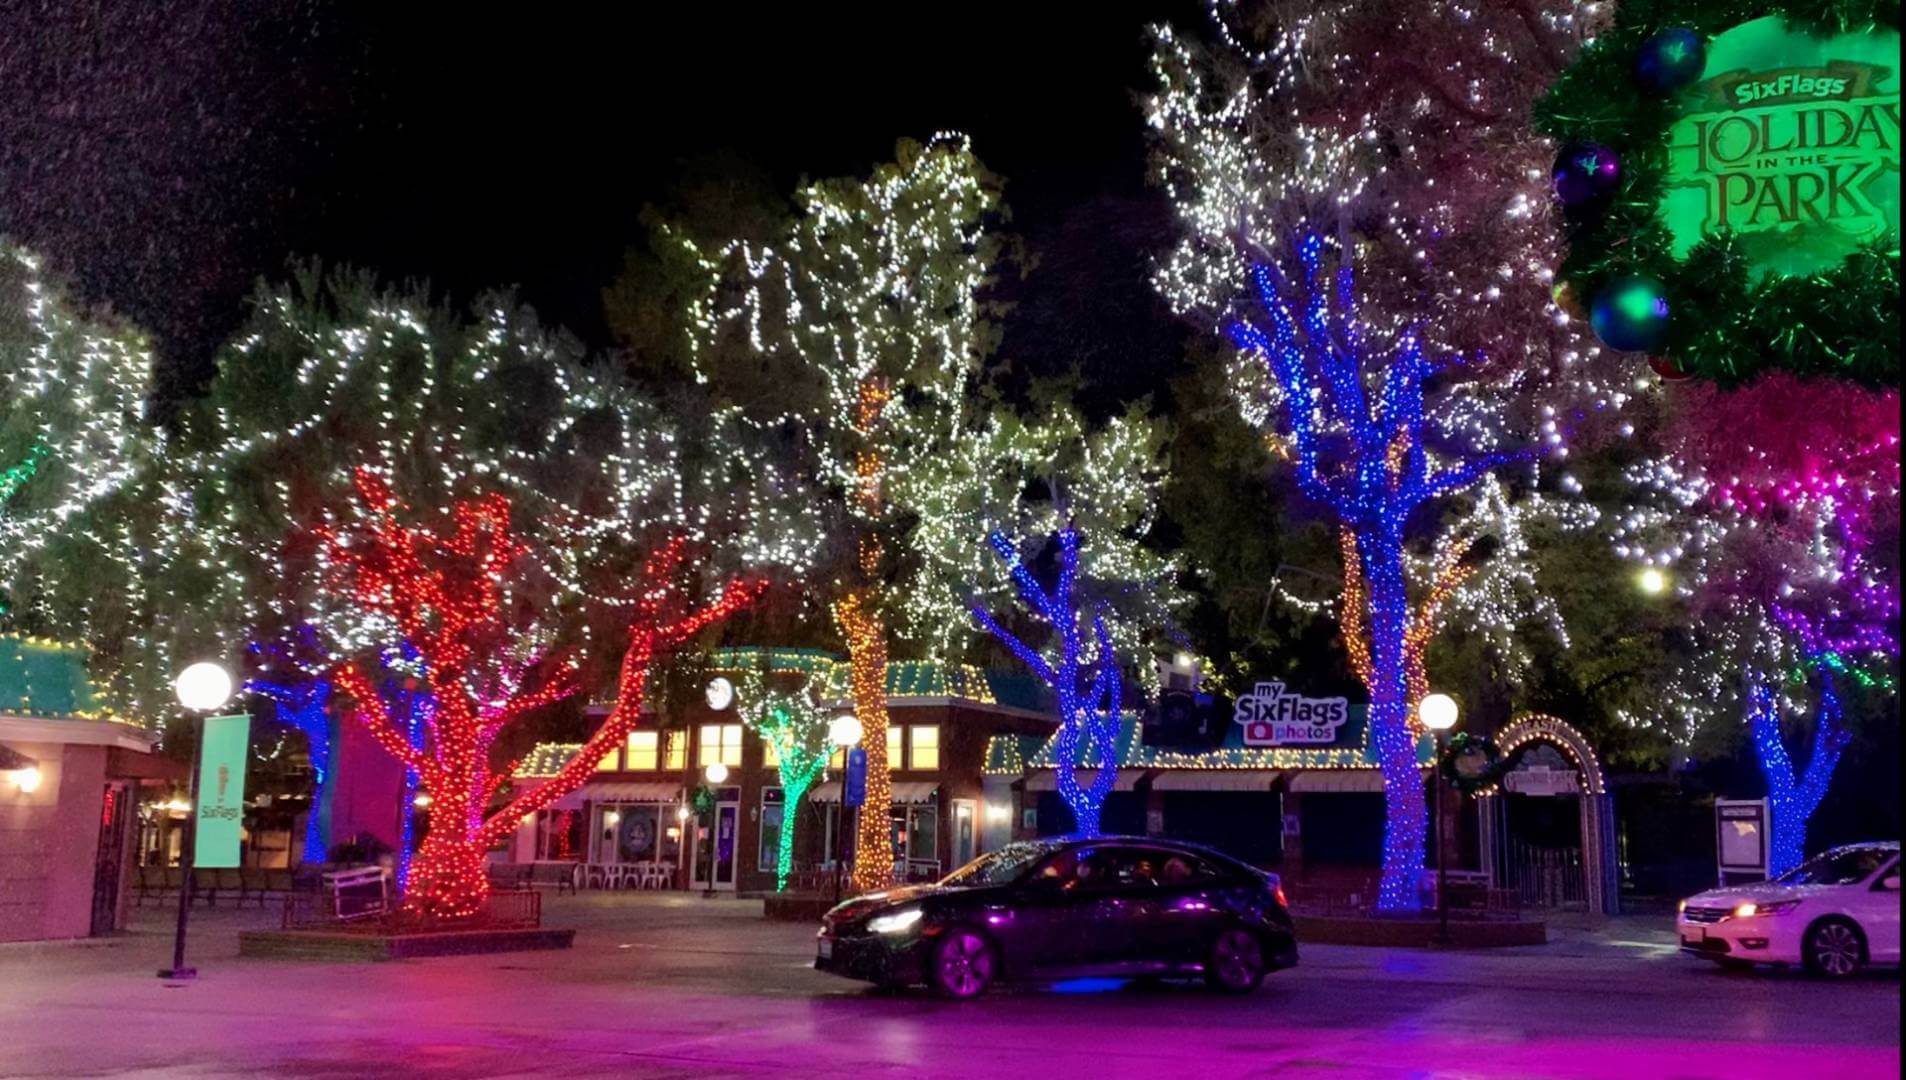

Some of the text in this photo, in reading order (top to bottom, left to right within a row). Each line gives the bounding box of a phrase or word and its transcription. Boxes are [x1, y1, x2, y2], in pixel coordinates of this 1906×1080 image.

[1735, 74, 1849, 104] SixFlags
[1756, 154, 1828, 169] IN THE
[1712, 162, 1876, 229] PARK
[1256, 684, 1282, 700] my
[1238, 698, 1345, 726] SixFlags
[1275, 725, 1332, 743] photos
